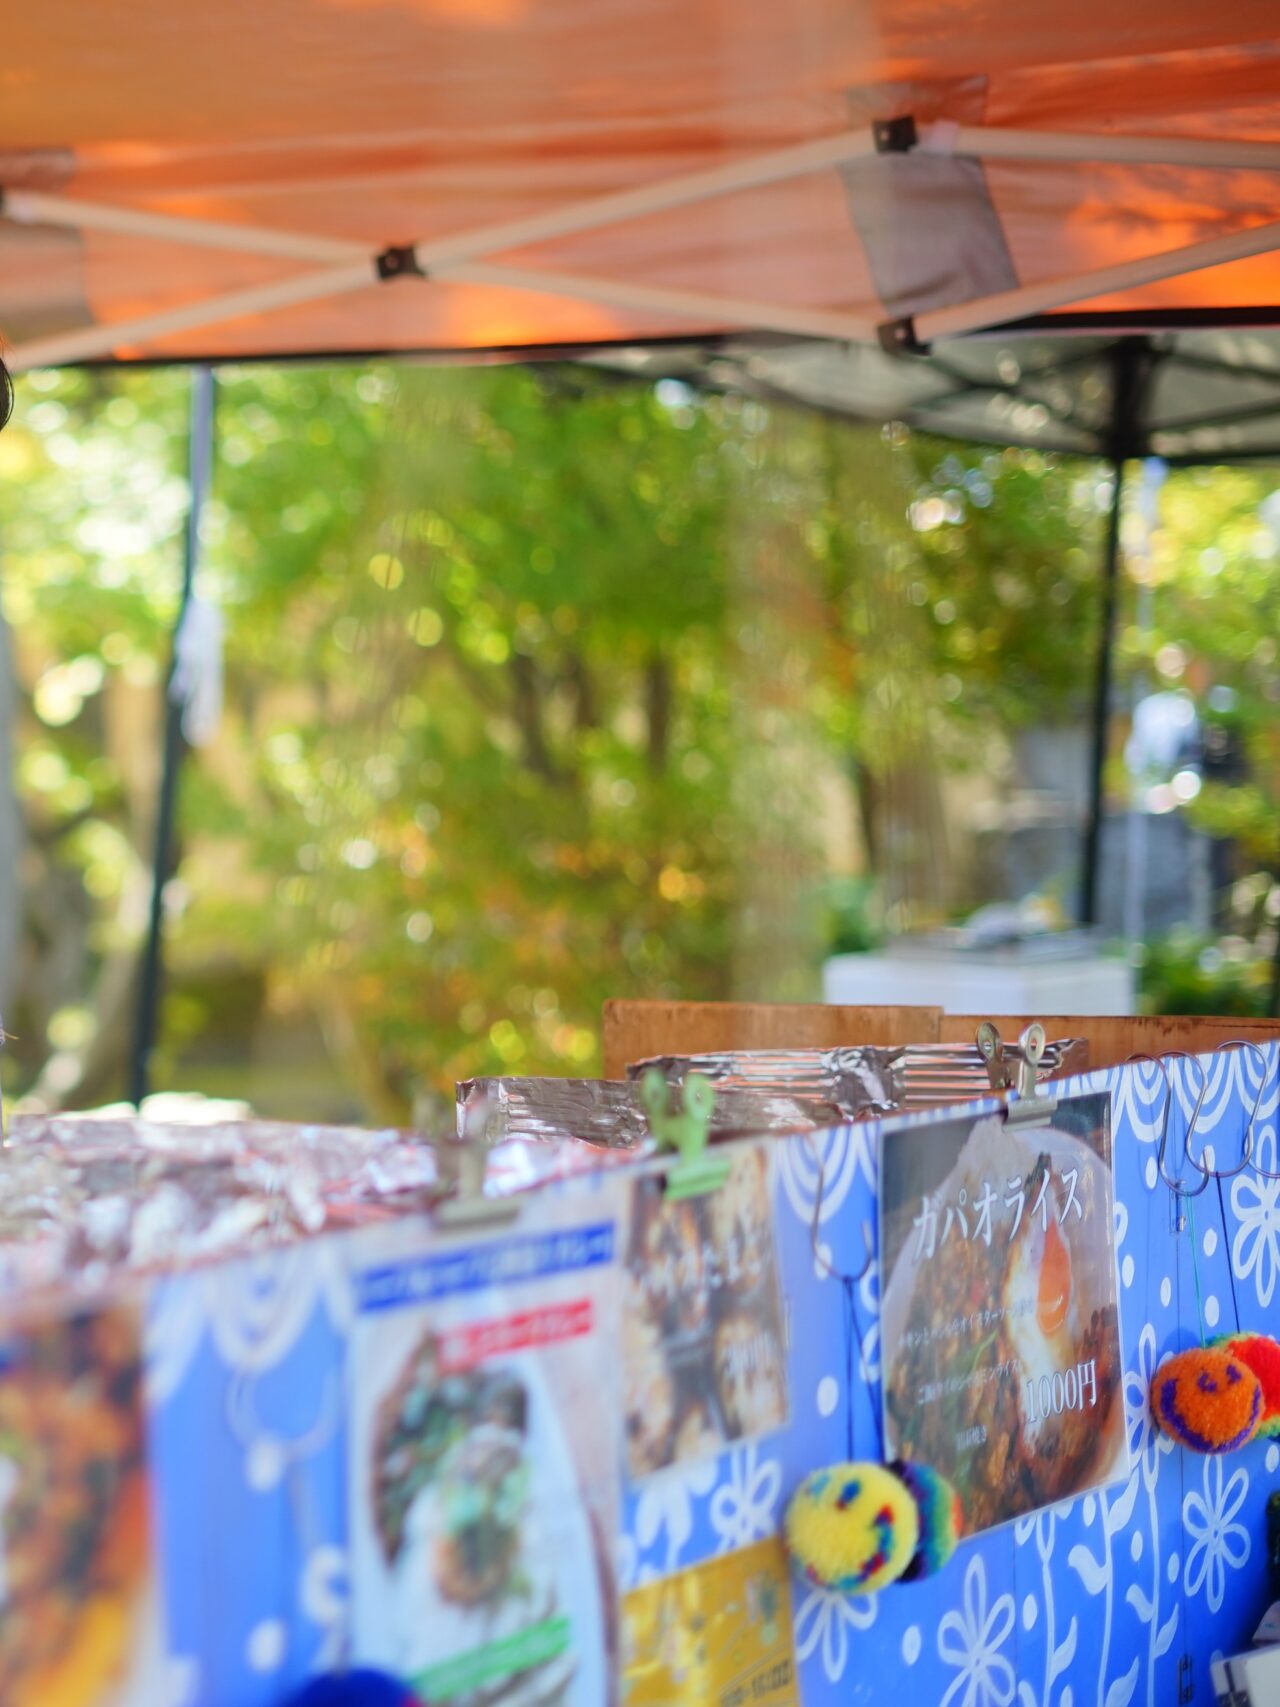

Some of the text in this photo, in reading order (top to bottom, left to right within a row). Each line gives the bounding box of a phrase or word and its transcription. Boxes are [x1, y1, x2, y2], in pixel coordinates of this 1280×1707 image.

[913, 1167, 1084, 1261] ガパオライス
[1025, 1358, 1098, 1425] 1000円
